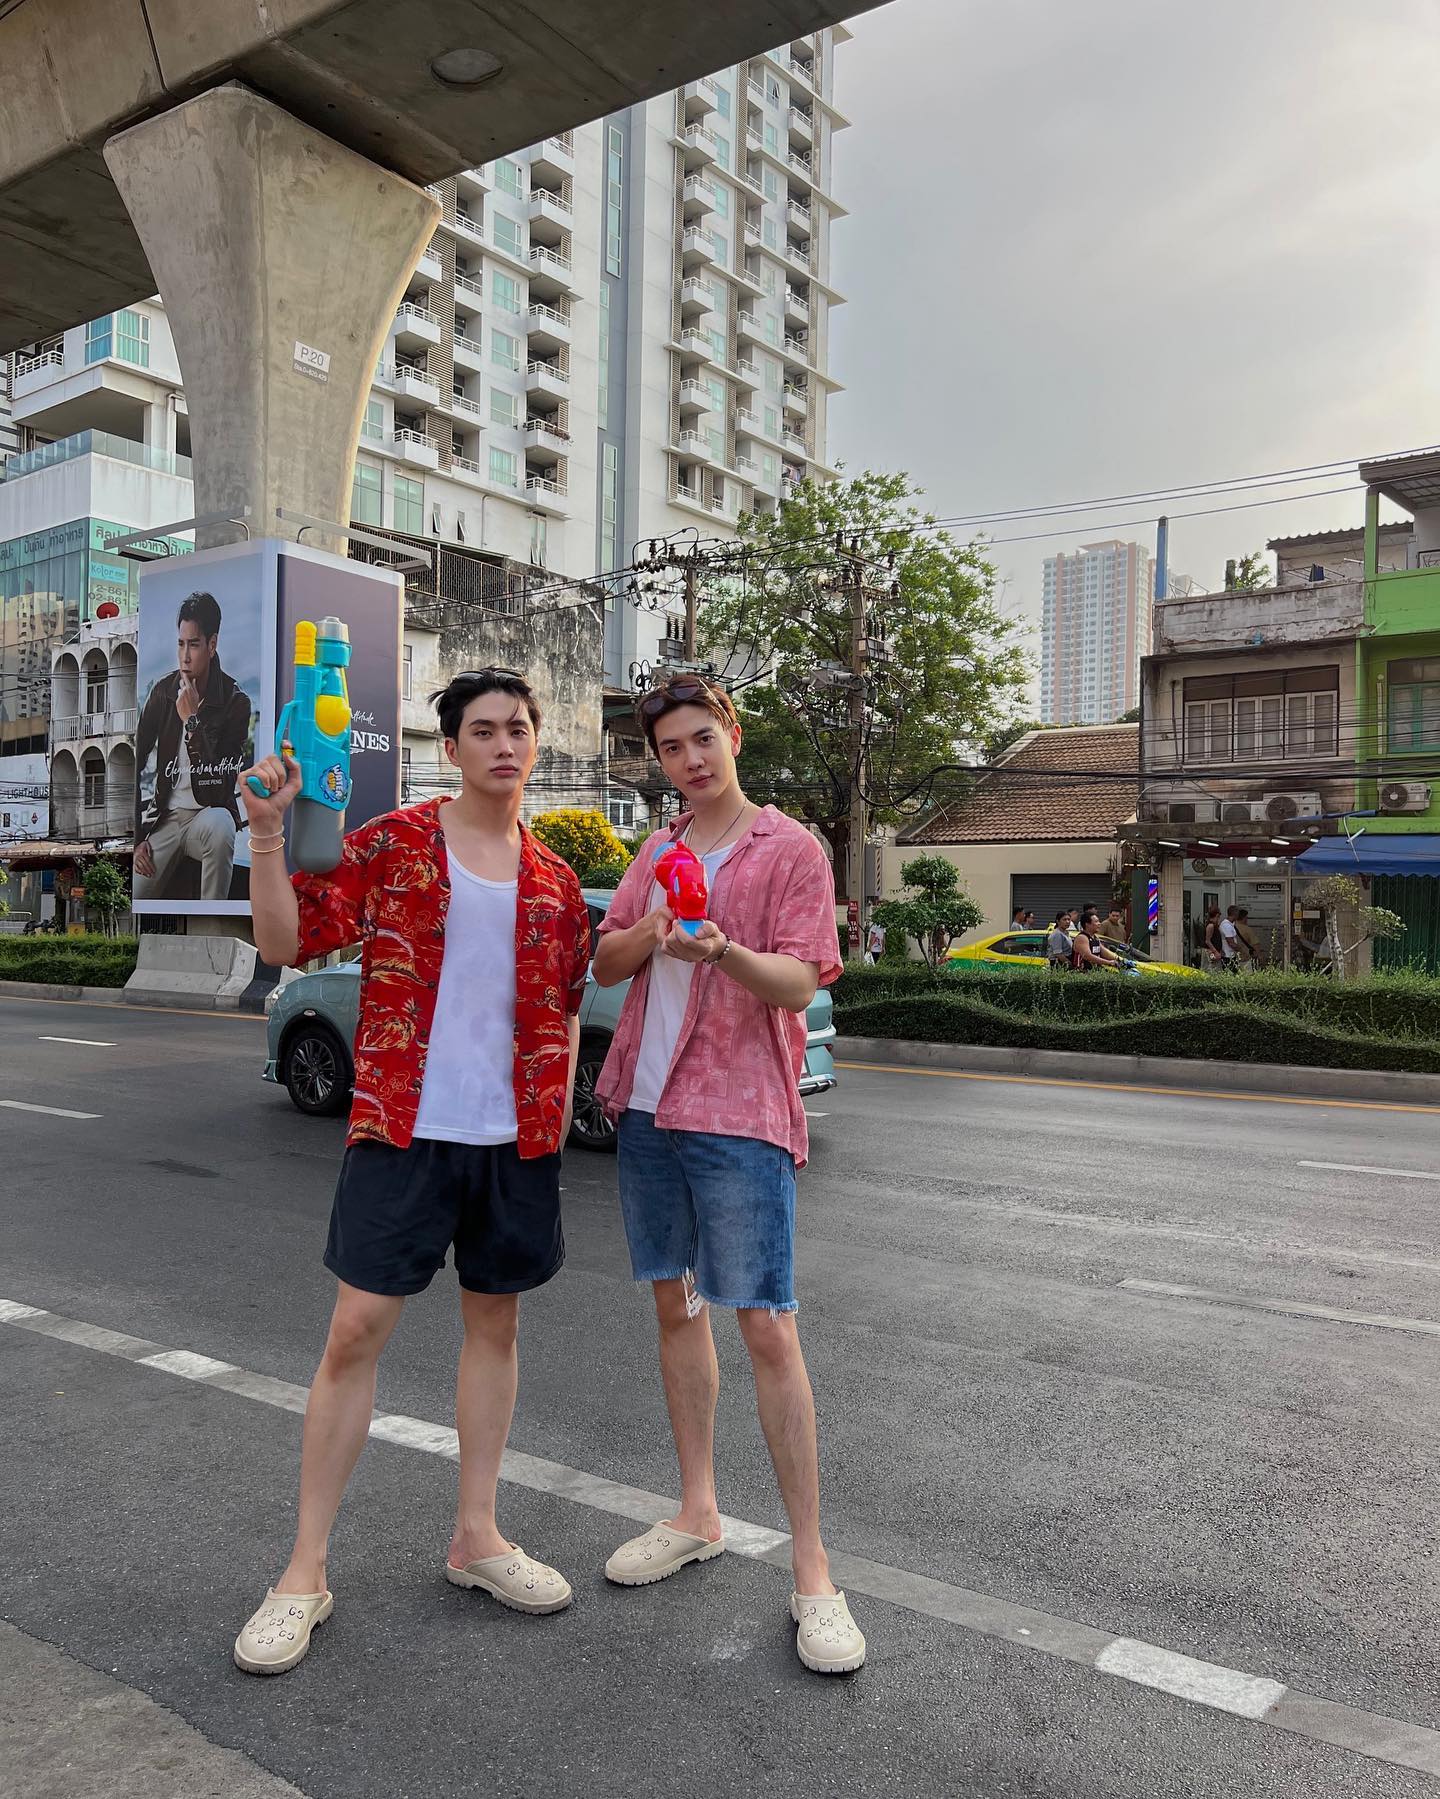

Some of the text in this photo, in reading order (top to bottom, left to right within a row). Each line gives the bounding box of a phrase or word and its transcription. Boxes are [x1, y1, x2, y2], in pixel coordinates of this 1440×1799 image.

[300, 346, 324, 366] P.20
[350, 730, 390, 752] NES
[333, 764, 344, 798] WATER
